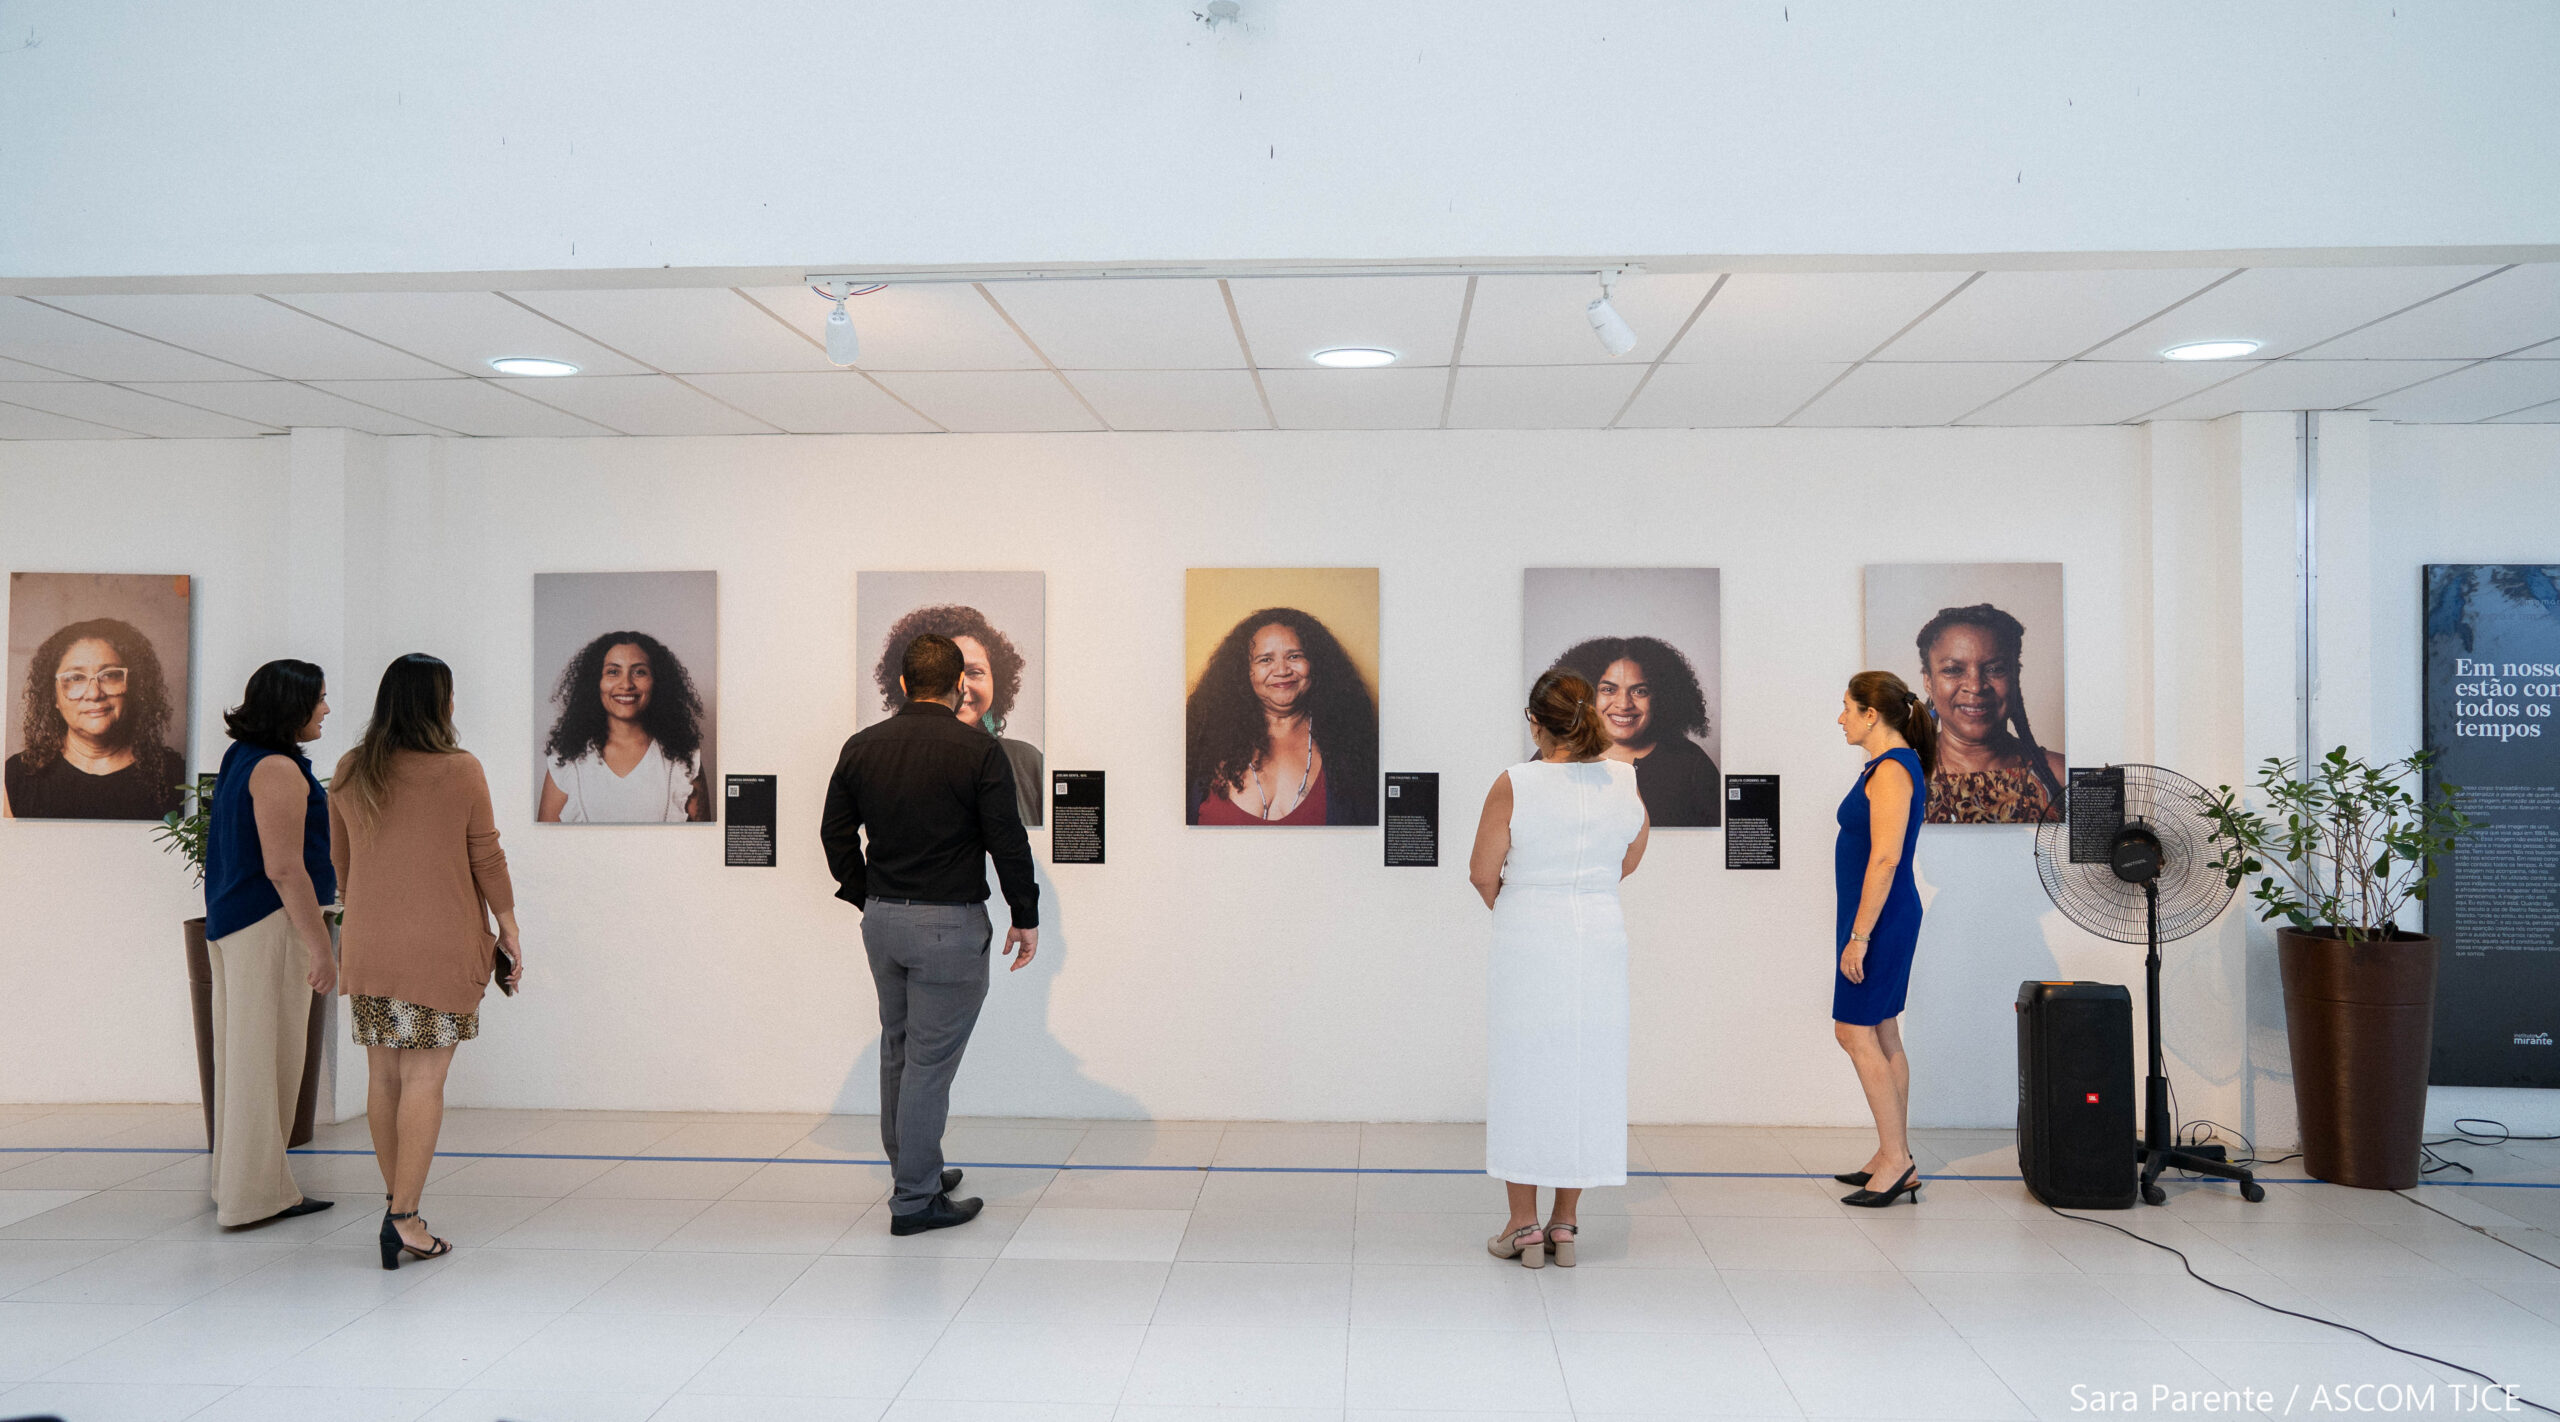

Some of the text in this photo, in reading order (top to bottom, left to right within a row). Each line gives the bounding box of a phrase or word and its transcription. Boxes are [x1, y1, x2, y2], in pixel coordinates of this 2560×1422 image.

[2456, 658, 2494, 676] Em
[2455, 678, 2516, 696] estão
[2456, 699, 2551, 717] todos os
[2456, 720, 2540, 742] tempos
